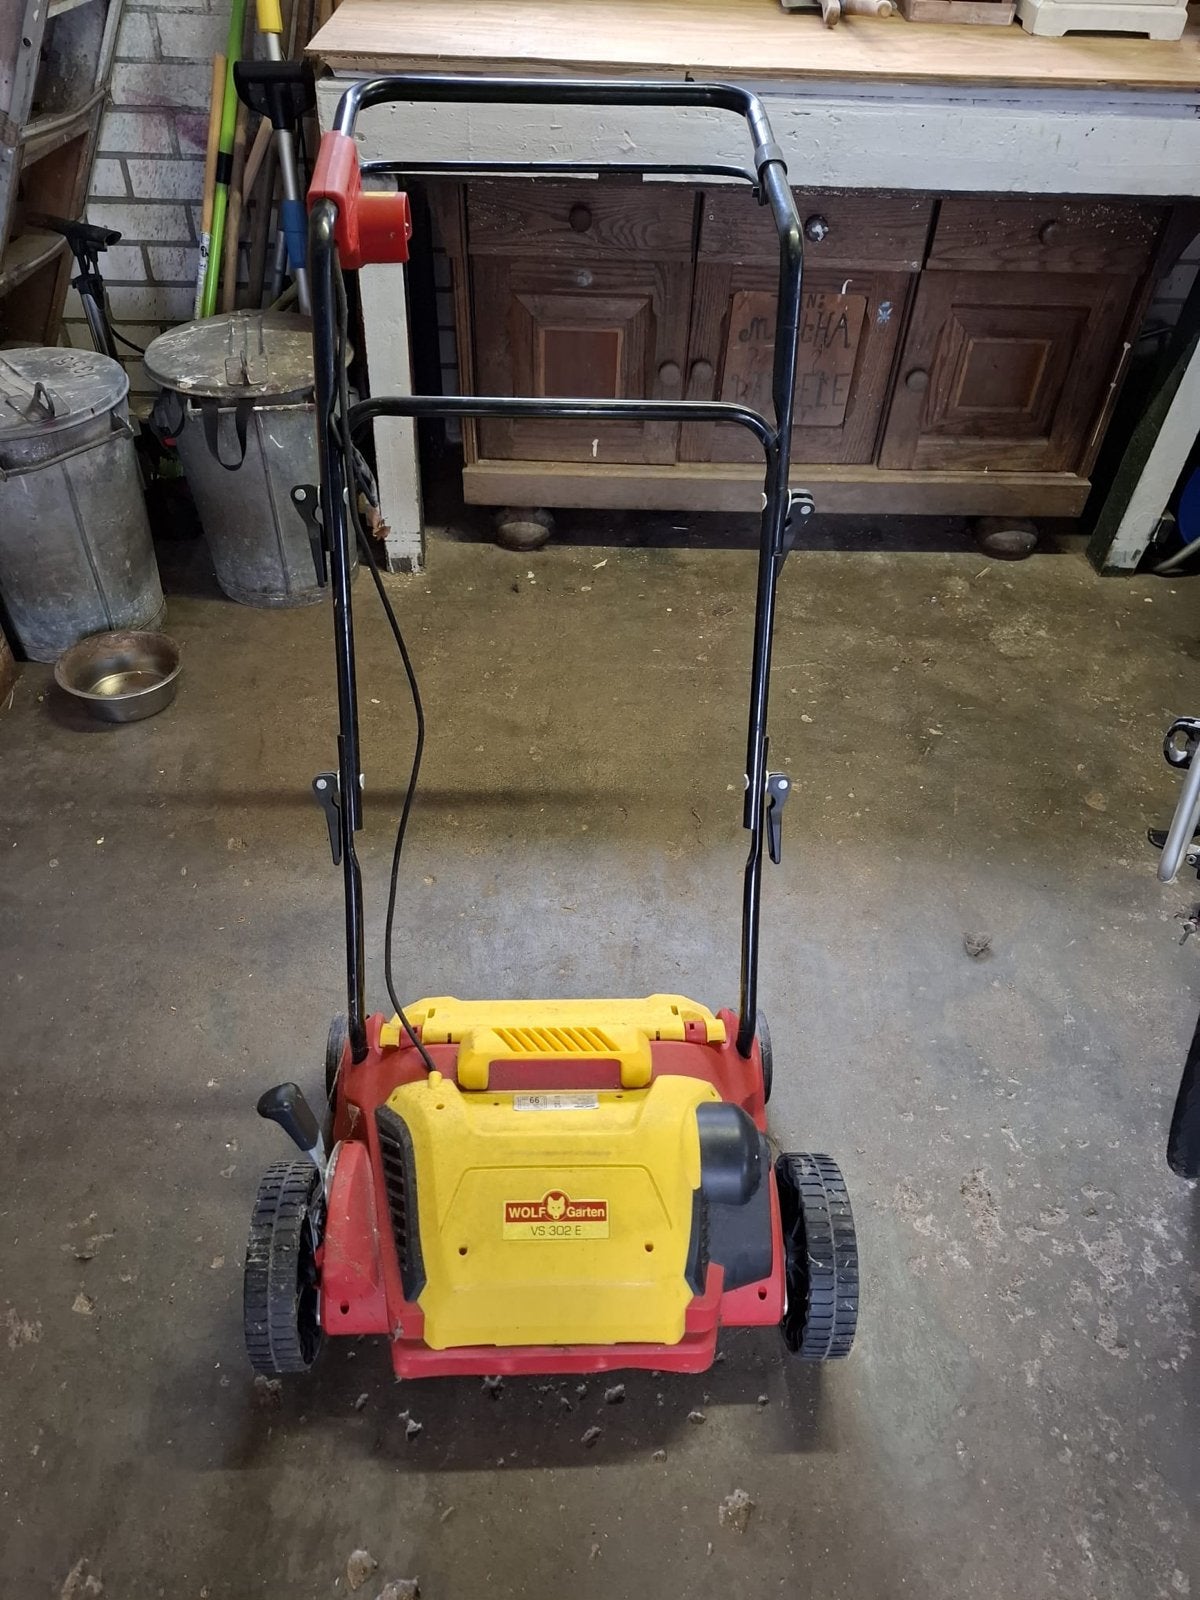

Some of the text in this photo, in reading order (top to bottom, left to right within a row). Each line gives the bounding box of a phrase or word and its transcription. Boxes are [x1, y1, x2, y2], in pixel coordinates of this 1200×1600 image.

[529, 1096, 540, 1104] 66
[508, 1206, 606, 1219] WOLF Garten
[530, 1225, 582, 1236] VS 302 E
